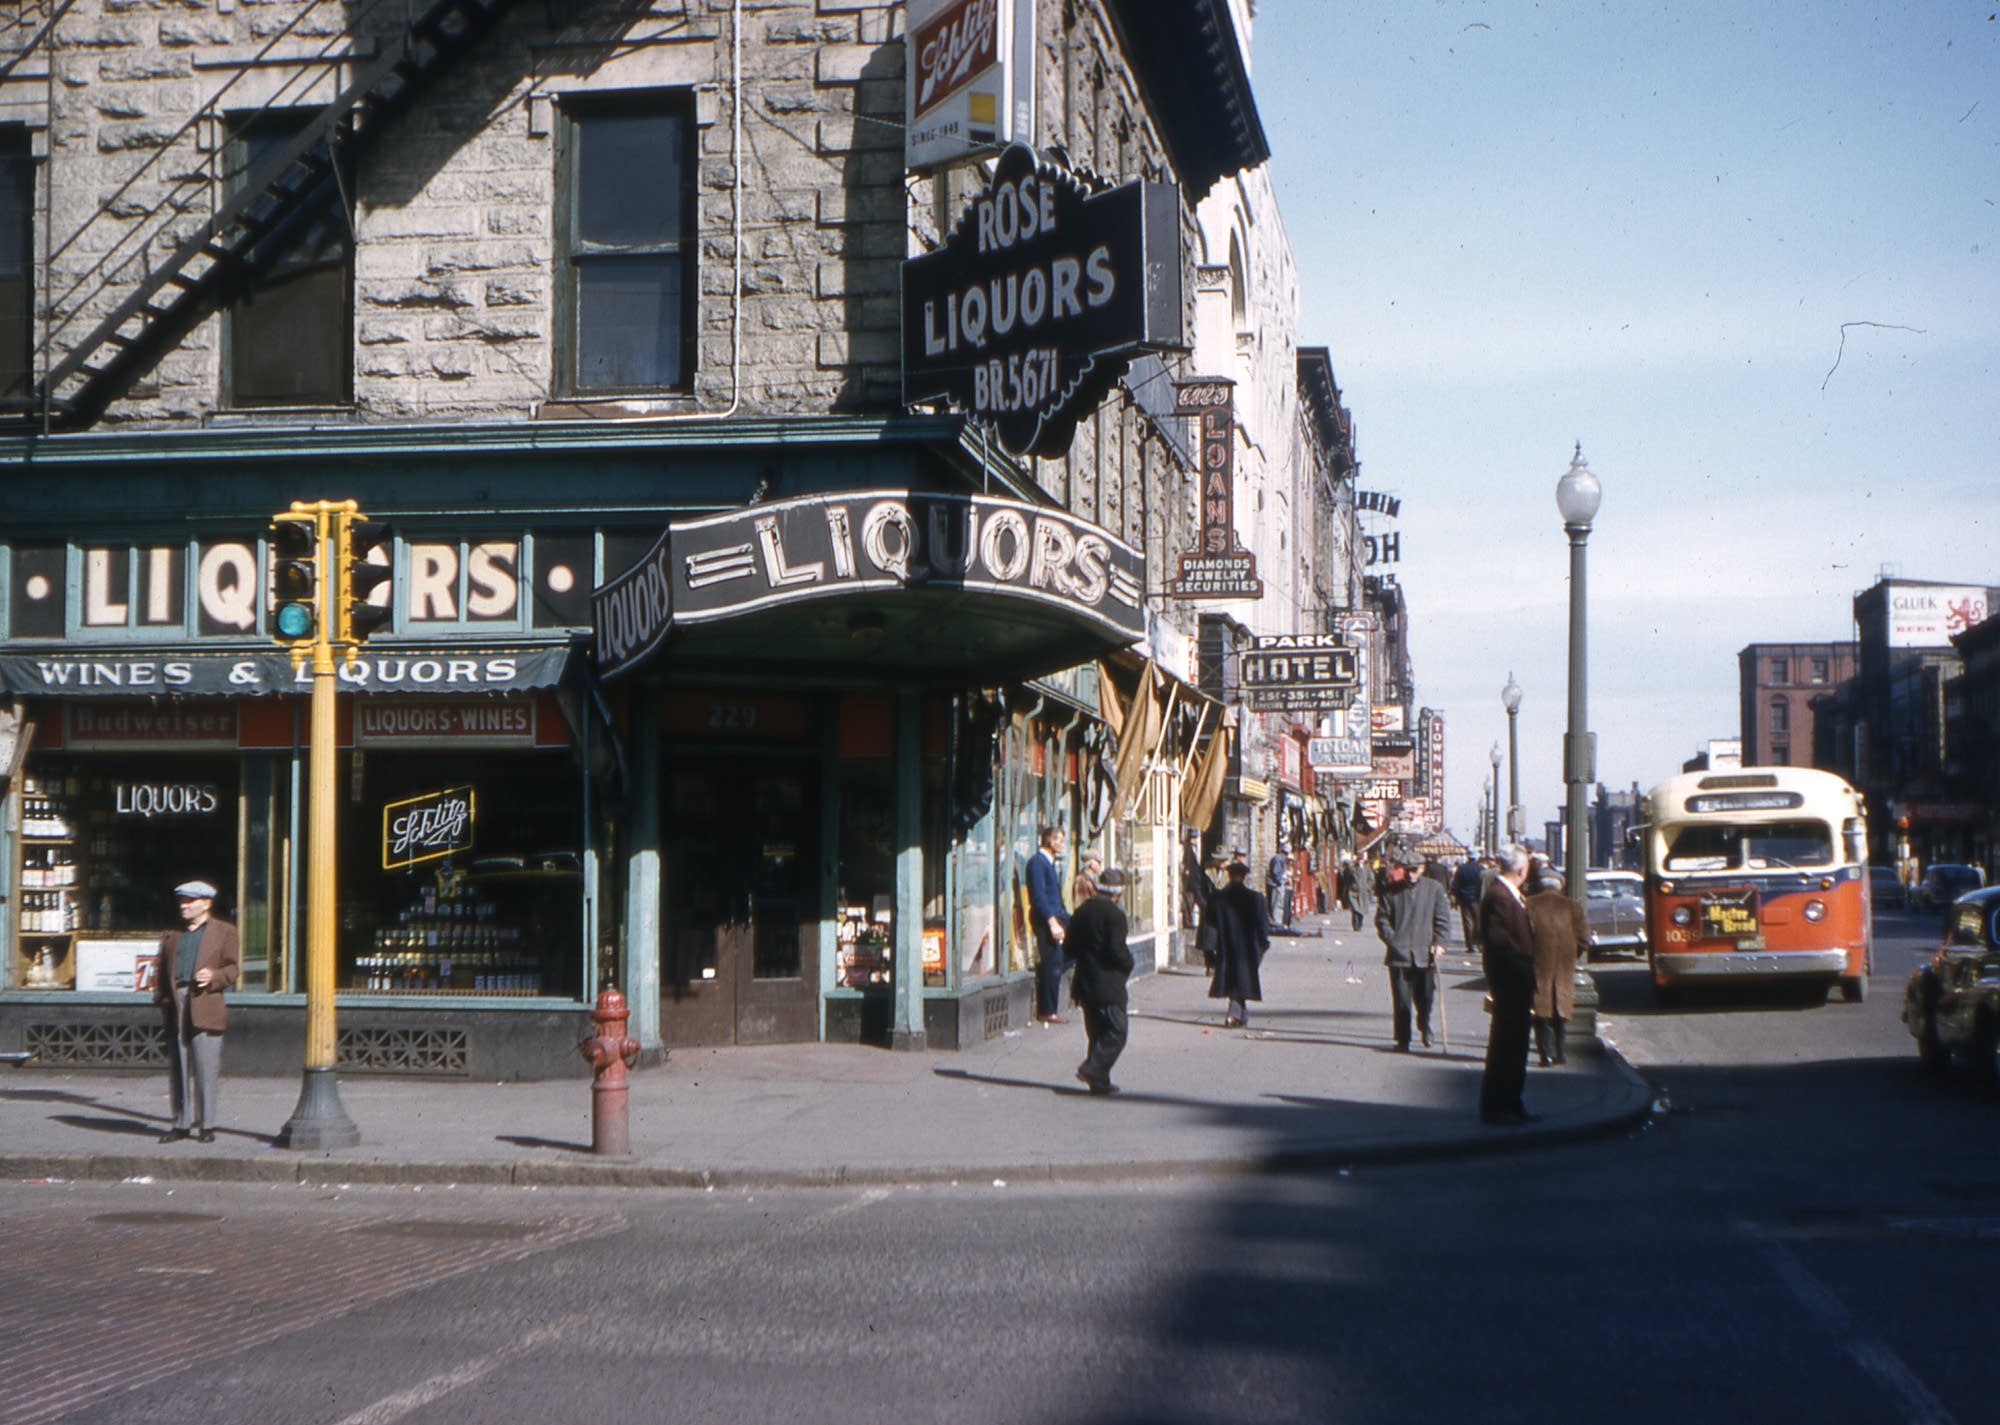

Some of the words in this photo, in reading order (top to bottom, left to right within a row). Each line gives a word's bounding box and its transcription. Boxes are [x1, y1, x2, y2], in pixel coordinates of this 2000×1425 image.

[920, 0, 995, 105] Schlitz
[911, 127, 935, 147] SINCE
[978, 174, 1056, 252] ROSE
[924, 245, 1115, 356] LIQUORS
[1206, 414, 1226, 552] LOANS
[755, 501, 1111, 605] LIQUORS
[1183, 558, 1250, 570] DIAMONDS
[86, 542, 518, 630] LIQRS
[1175, 580, 1258, 593] SECURITIES
[1186, 570, 1247, 581] JEWELRY
[599, 547, 670, 662] LIQUORS
[1893, 594, 1937, 609] GLUEK
[1259, 634, 1336, 648] PARK
[37, 662, 193, 686] WINES
[228, 663, 261, 685] &
[294, 659, 518, 685] LQUORS
[1246, 655, 1354, 681] HOTEL
[77, 704, 231, 732] Budweiser
[364, 708, 449, 733] LIQUORS
[460, 708, 527, 731] WINES
[117, 785, 217, 817] LIQUORS
[391, 799, 467, 853] Schlitz
